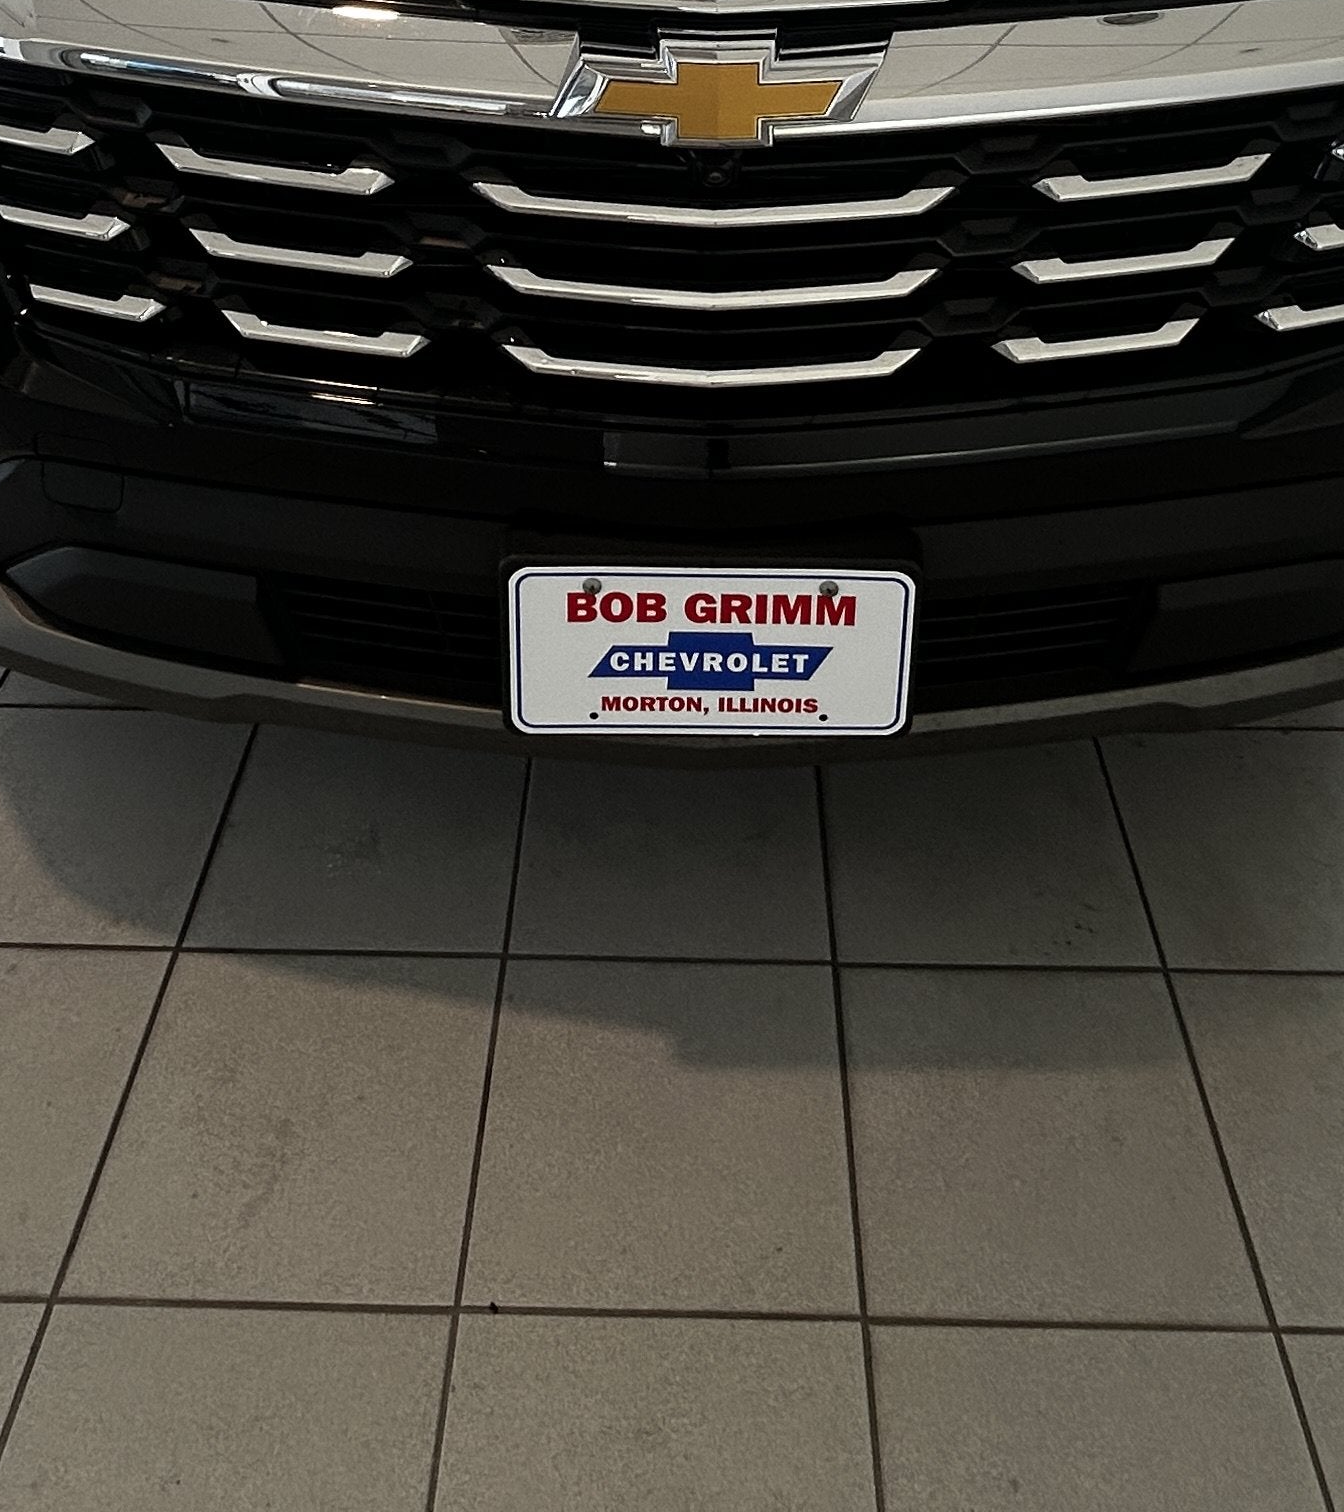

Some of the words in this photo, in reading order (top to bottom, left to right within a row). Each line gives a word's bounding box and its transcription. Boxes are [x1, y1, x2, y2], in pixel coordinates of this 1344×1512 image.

[567, 591, 668, 623] BOB
[684, 593, 856, 626] GRIMM
[610, 652, 809, 673] CHEVROLET
[601, 696, 709, 716] MORTON,
[718, 697, 819, 714] ILLINOIS
